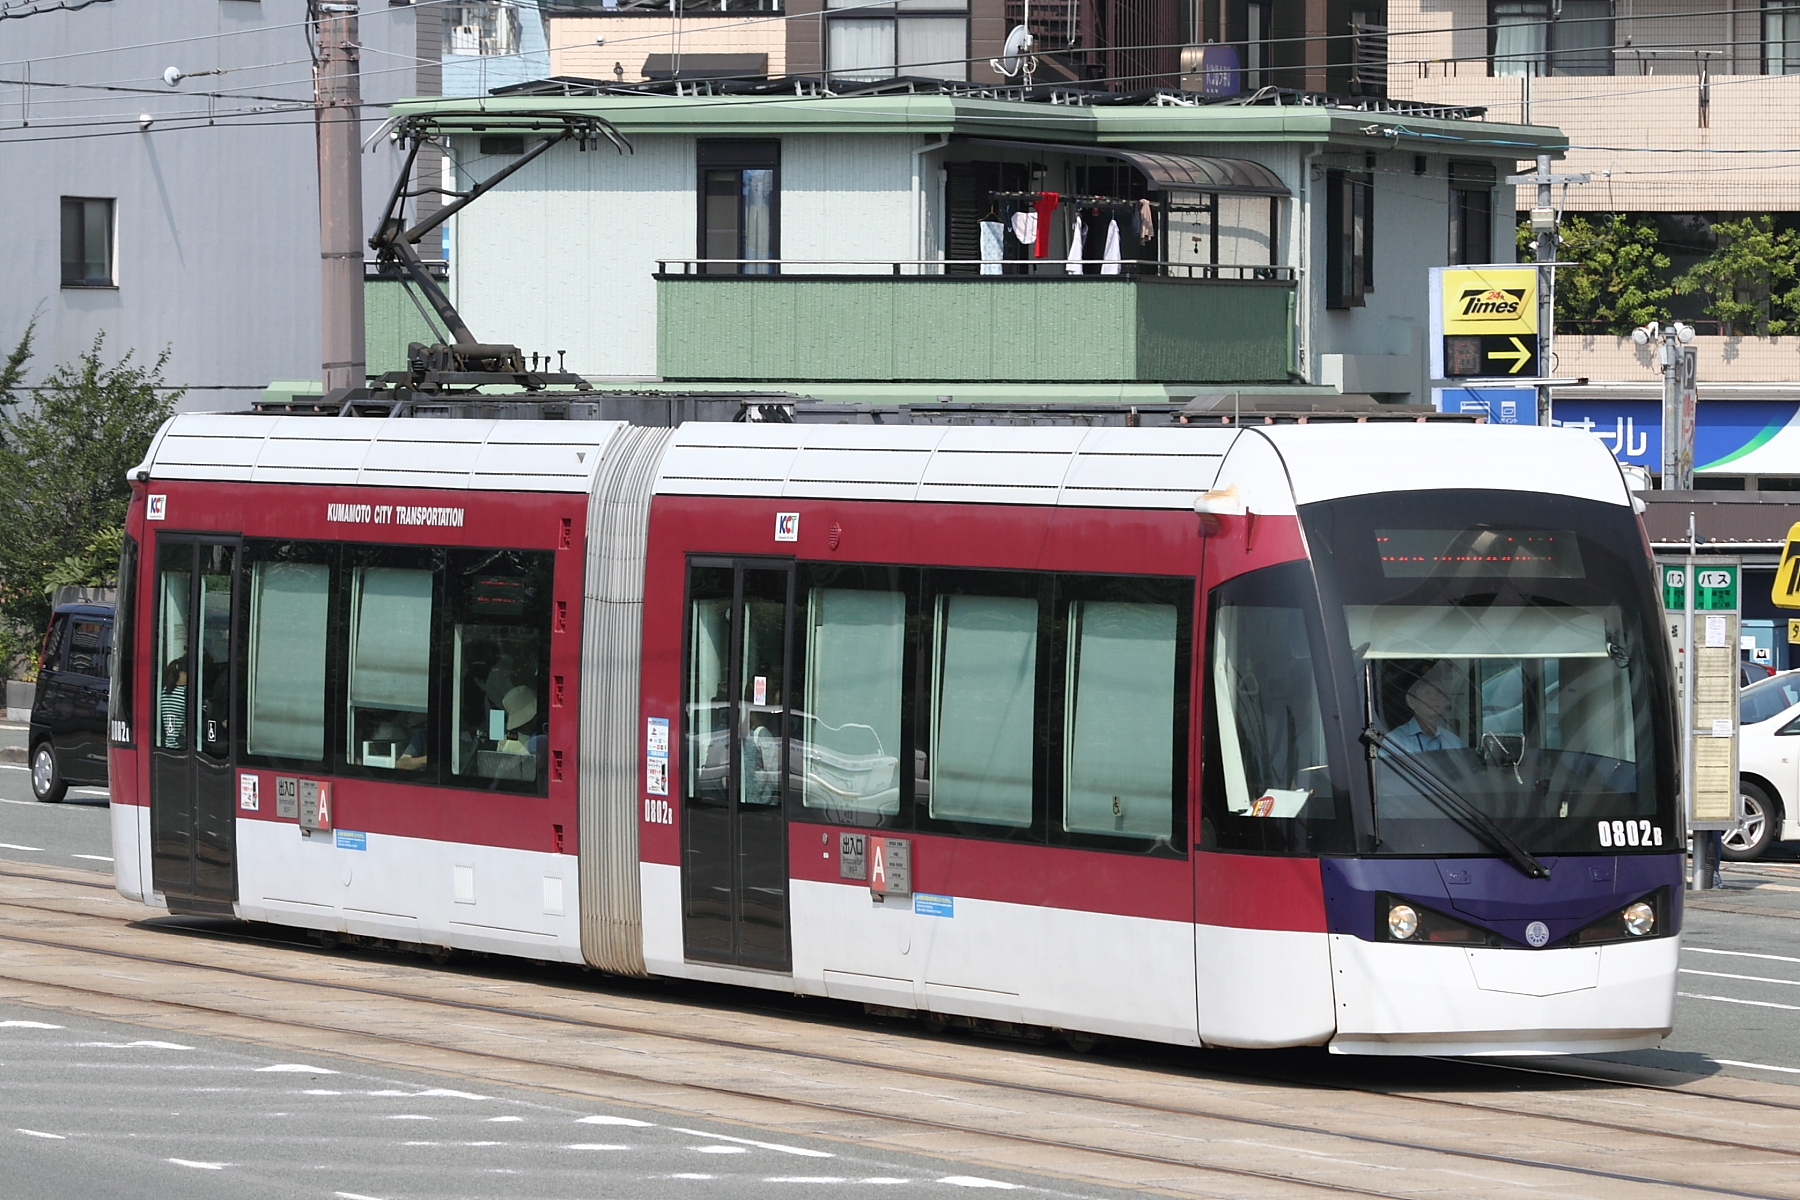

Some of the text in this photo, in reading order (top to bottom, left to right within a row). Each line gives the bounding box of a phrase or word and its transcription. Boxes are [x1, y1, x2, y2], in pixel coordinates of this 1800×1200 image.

[1462, 297, 1519, 315] Times
[150, 497, 165, 514] KCT
[327, 503, 464, 527] KUMAMOTO CITY TRANSPORTATION
[779, 515, 798, 534] KCT
[1701, 574, 1728, 584] バス
[279, 780, 295, 796] 出入口
[319, 789, 328, 822] A
[645, 799, 673, 824] 0802B
[1598, 820, 1663, 847] 0802B
[843, 836, 863, 855] 出入口
[872, 846, 885, 883] A
